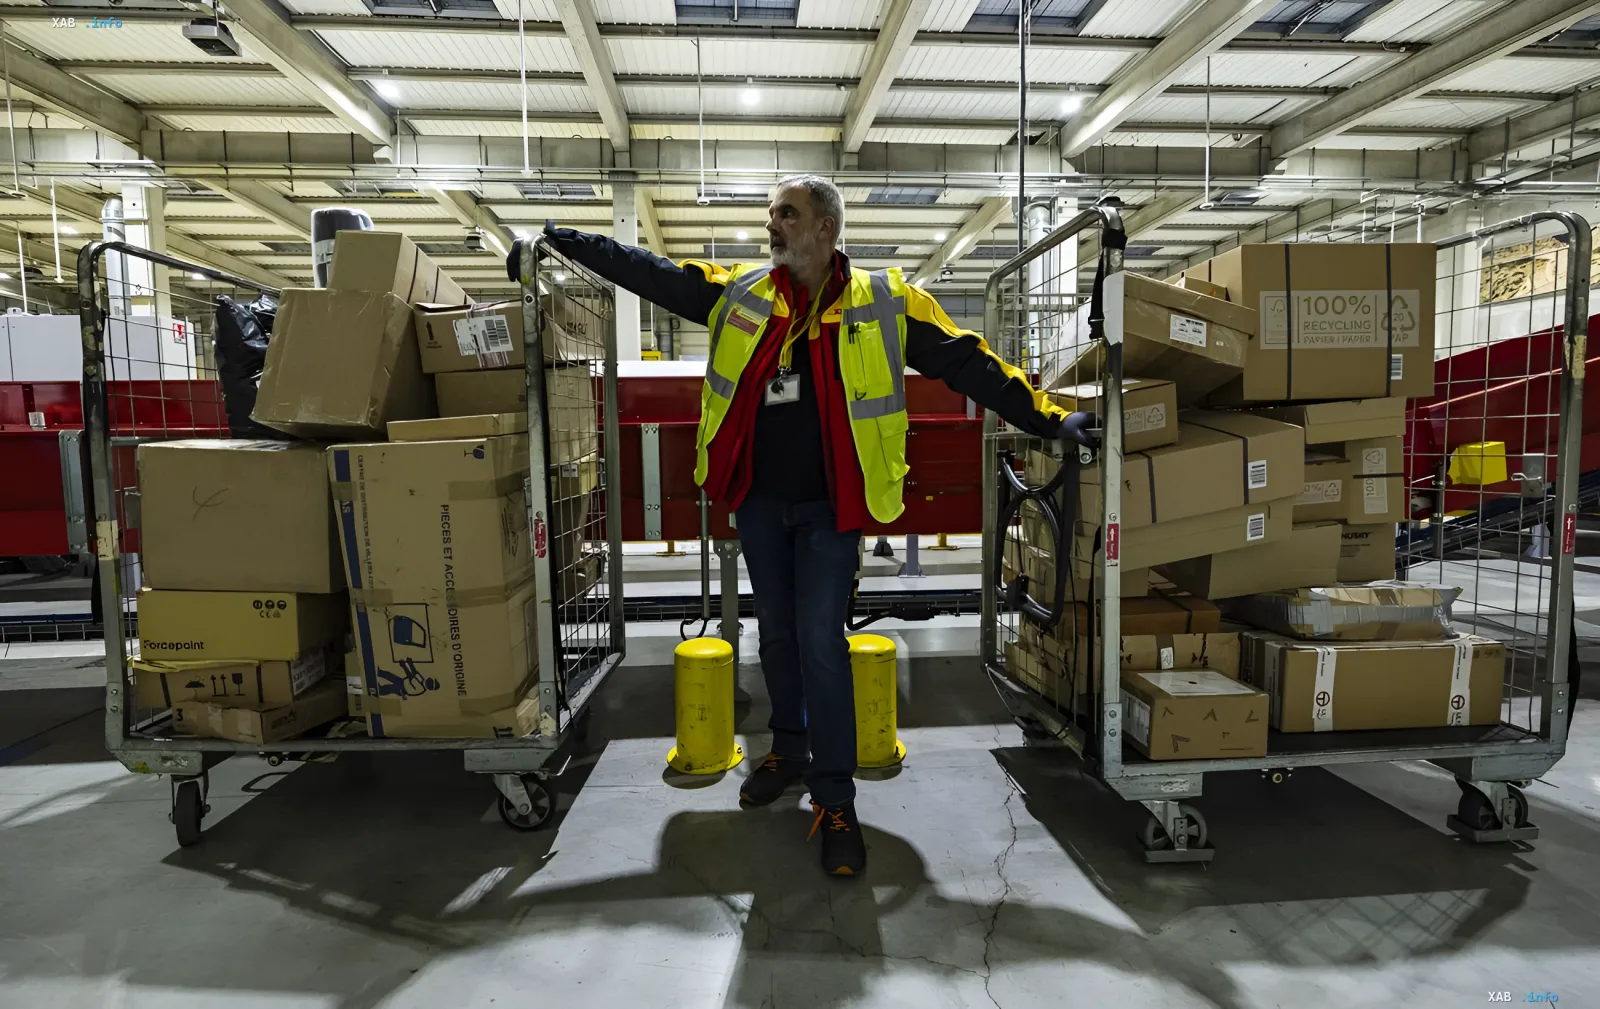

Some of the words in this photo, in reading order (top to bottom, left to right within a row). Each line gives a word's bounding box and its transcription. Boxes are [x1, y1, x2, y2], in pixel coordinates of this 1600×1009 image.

[1303, 295, 1371, 315] 100%
[1303, 320, 1371, 331] RECYCLING
[441, 504, 452, 544] PIECES
[443, 547, 453, 560] ET
[143, 640, 205, 651] Forcepoint
[451, 643, 467, 697] D'ORIGINE
[176, 708, 183, 721] 3
